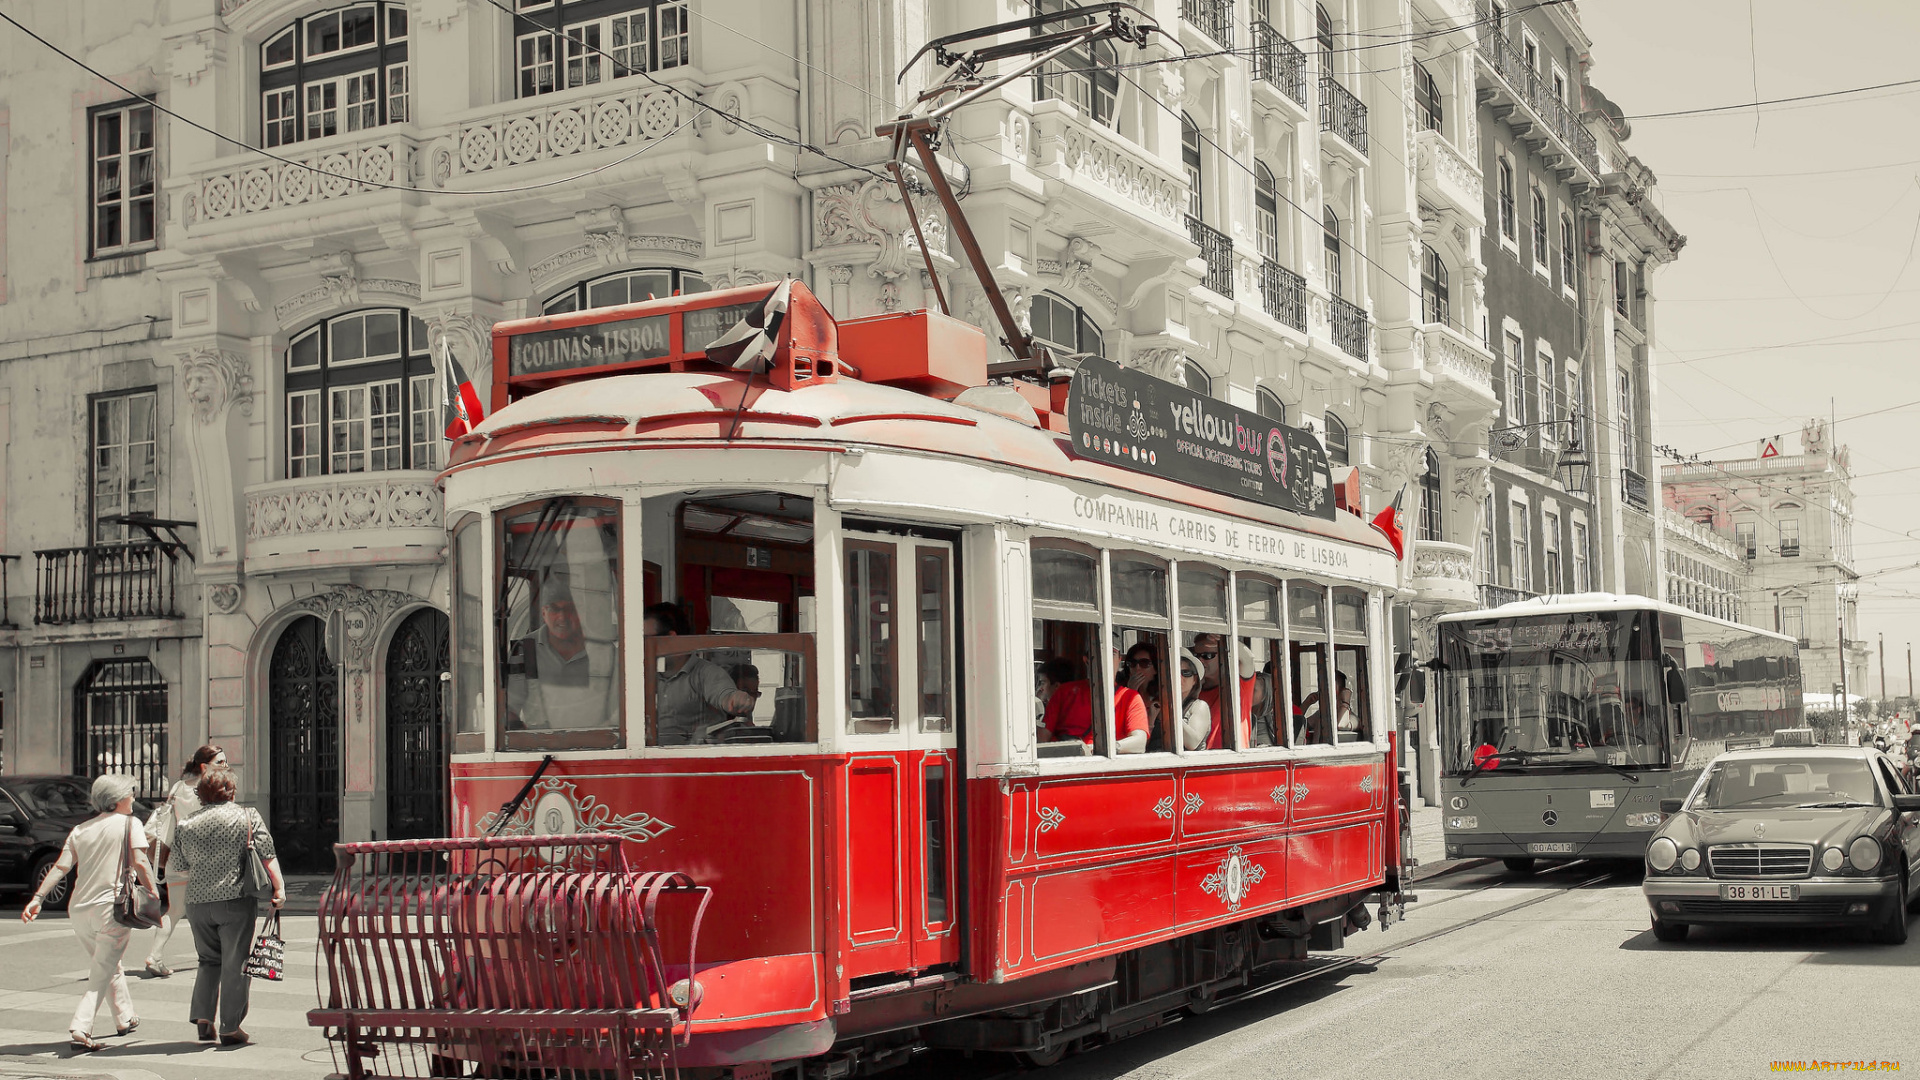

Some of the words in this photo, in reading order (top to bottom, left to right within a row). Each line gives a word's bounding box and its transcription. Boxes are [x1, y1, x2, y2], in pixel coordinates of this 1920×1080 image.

[522, 334, 591, 369] COLINAS
[592, 345, 603, 359] DE
[603, 322, 664, 357] LISBOA
[1077, 368, 1128, 409] Tickets
[1080, 397, 1122, 434] inside
[1176, 439, 1204, 460] OFFICIAL
[1205, 447, 1243, 471] SIGHTSEEING
[1243, 459, 1263, 477] TOURS
[1073, 494, 1159, 532] COMPANHIA
[1169, 516, 1217, 543] CARRIS
[1226, 529, 1240, 548] DE
[1248, 533, 1285, 556] FERRO
[1293, 542, 1306, 560] DE
[1311, 546, 1349, 568] LISBOA
[1469, 628, 1512, 652] 759
[1782, 731, 1801, 740] TAXI
[1602, 793, 1614, 801] TP
